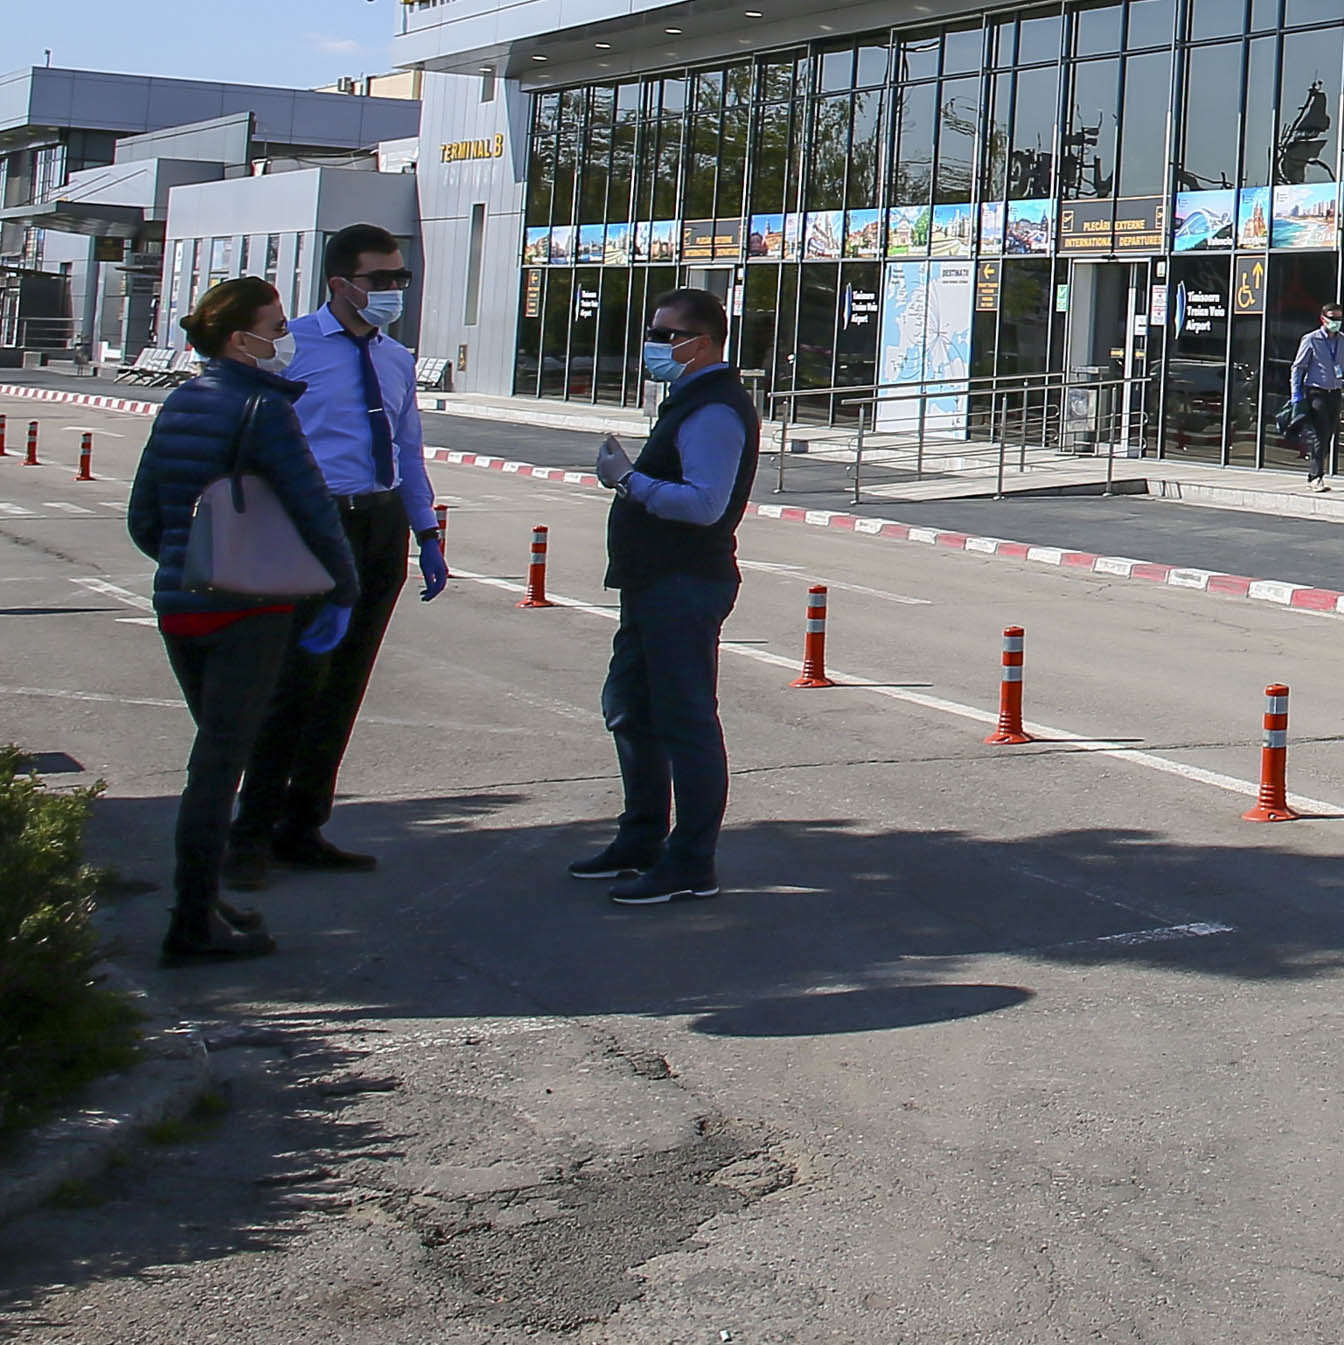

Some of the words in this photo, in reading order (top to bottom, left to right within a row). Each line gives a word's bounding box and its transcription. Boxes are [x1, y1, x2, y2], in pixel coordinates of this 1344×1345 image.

[440, 139, 492, 163] TERMINAL
[494, 133, 504, 158] B
[1064, 236, 1113, 248] INTERNATIONA
